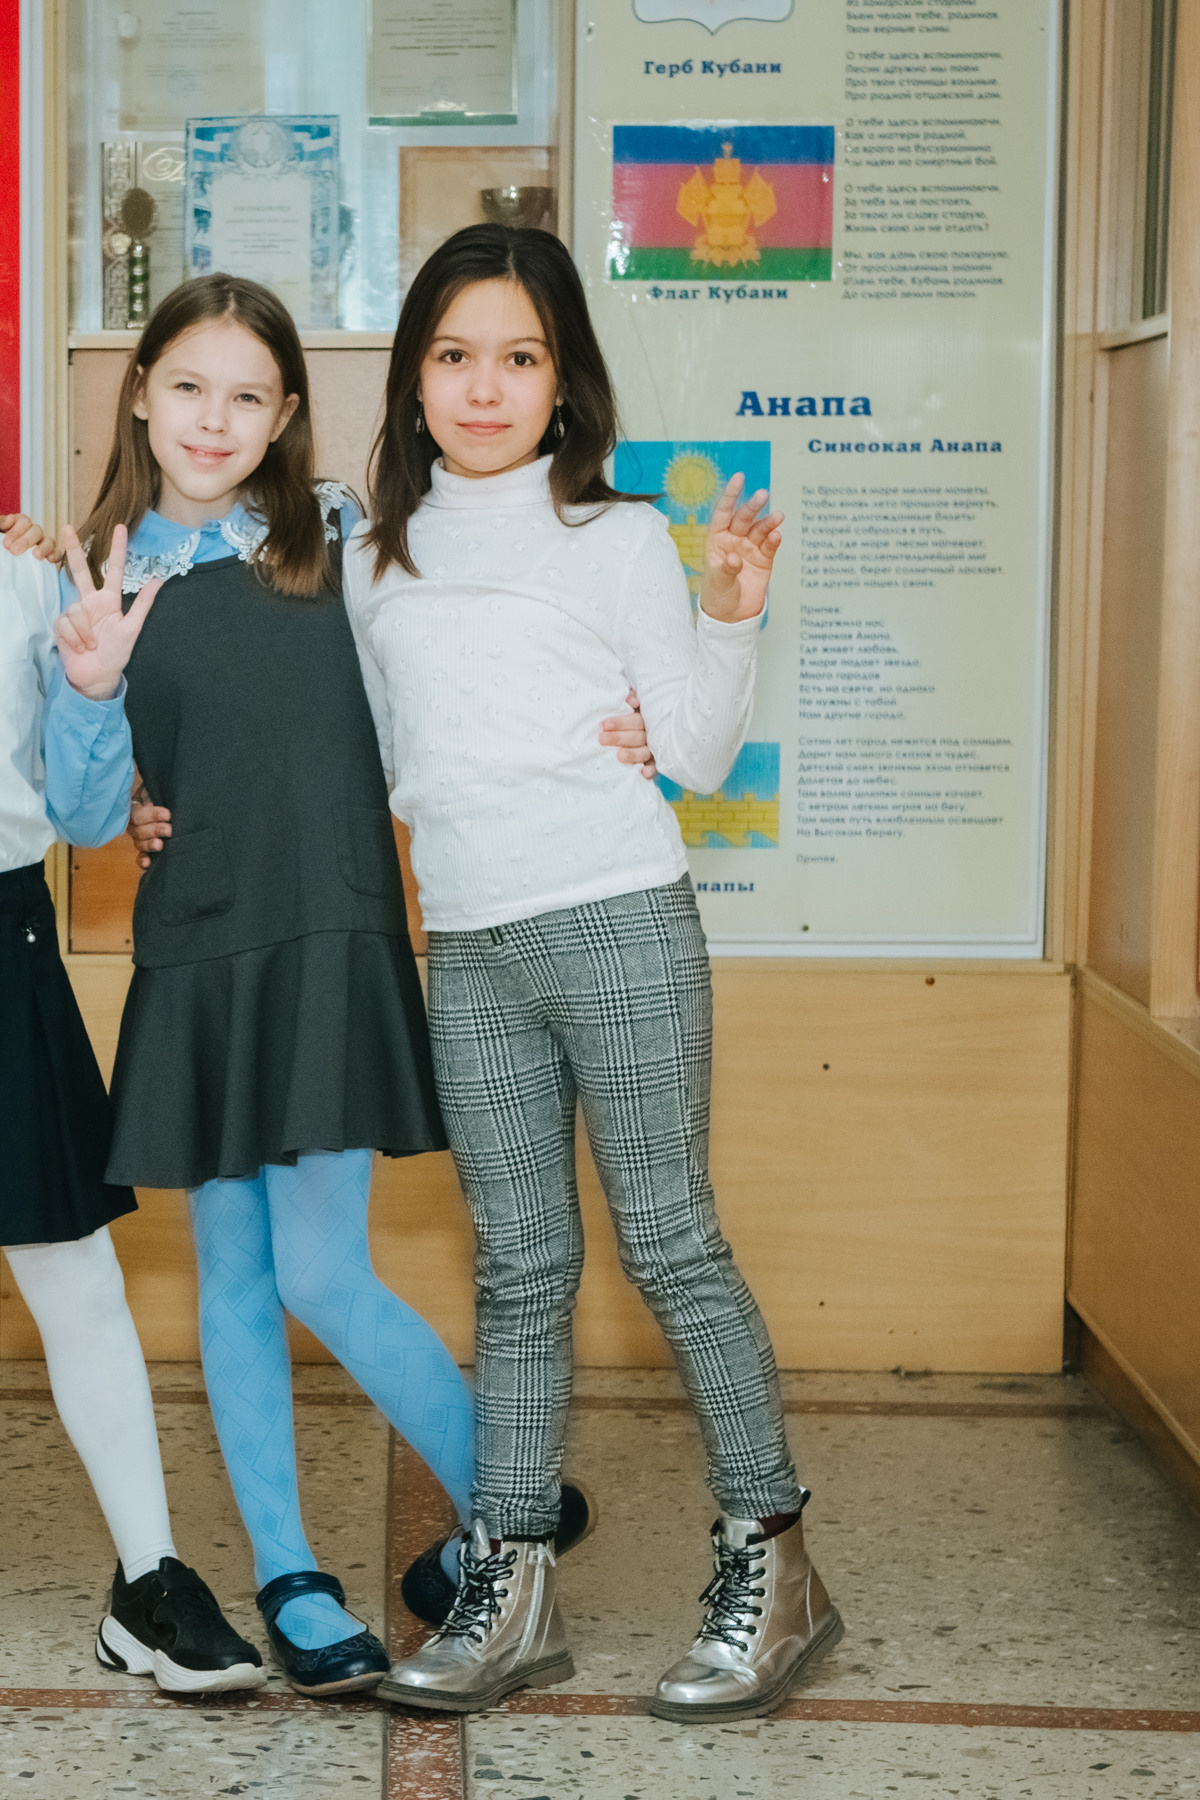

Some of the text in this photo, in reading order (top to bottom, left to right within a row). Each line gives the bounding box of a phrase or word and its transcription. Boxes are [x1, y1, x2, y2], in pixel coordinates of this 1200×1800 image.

[645, 59, 781, 76] Герб Кубани
[649, 285, 787, 303] Флаг Кубани
[736, 391, 871, 416] Анапа
[808, 439, 1001, 453] Синеокая Анапа
[697, 882, 755, 892] напы
